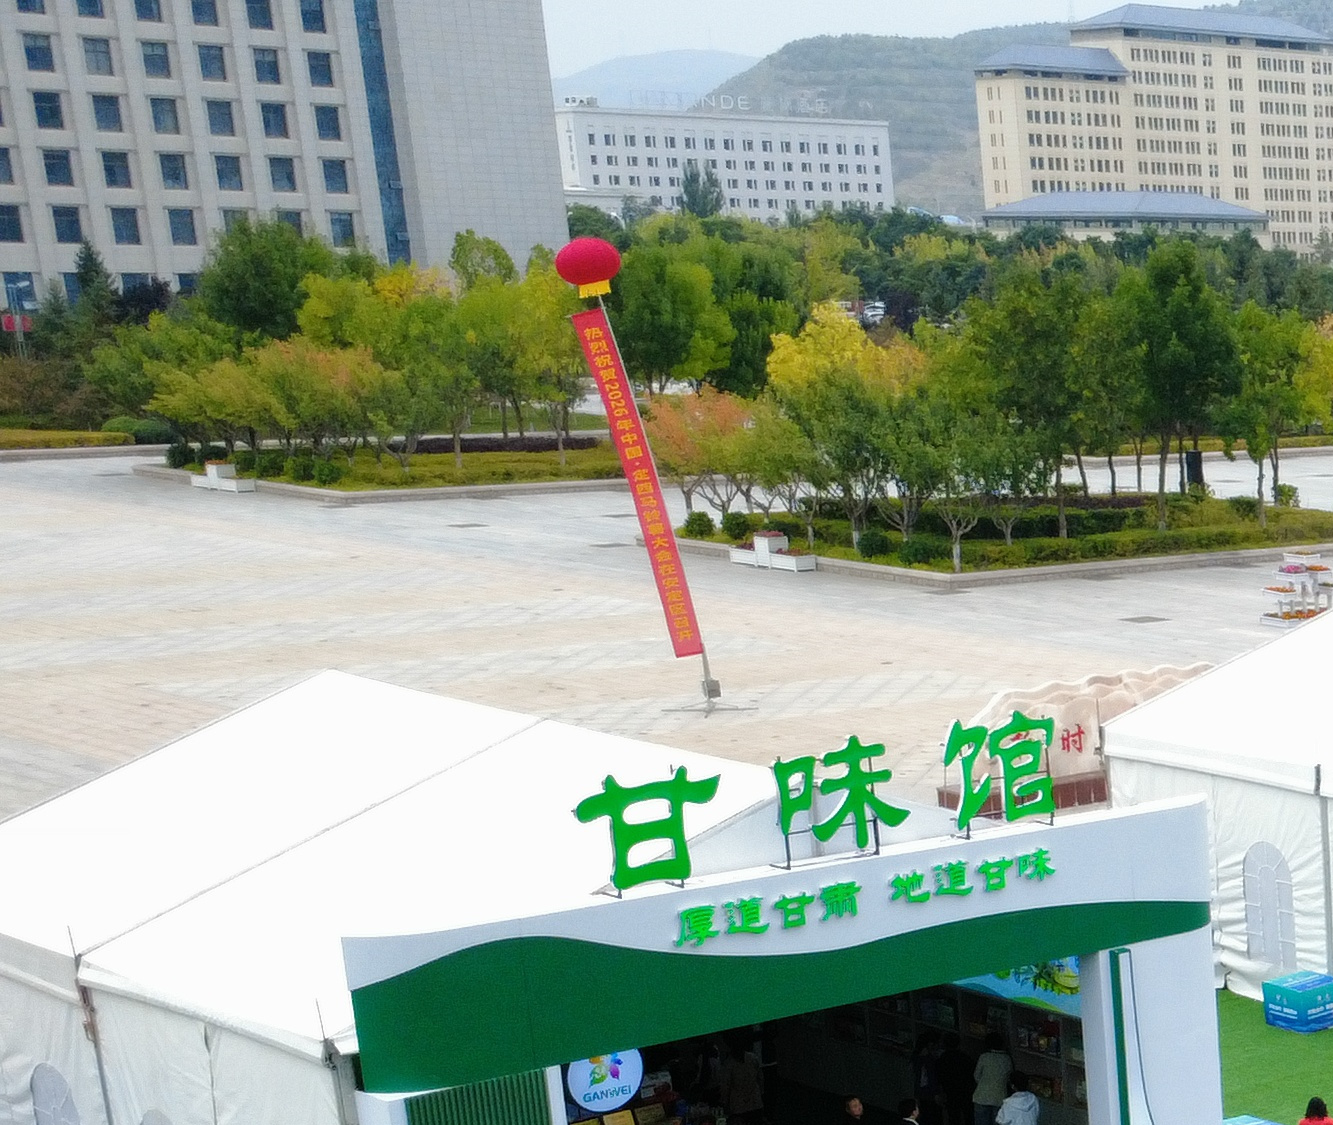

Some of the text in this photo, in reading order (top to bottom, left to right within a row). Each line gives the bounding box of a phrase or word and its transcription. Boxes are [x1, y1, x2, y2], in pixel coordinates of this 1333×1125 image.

[1061, 725, 1085, 753] 时
[574, 710, 1056, 890] 甘味馆
[674, 848, 1056, 947] 厚道甘肃 地道甘味
[582, 1084, 632, 1103] GANWEI
